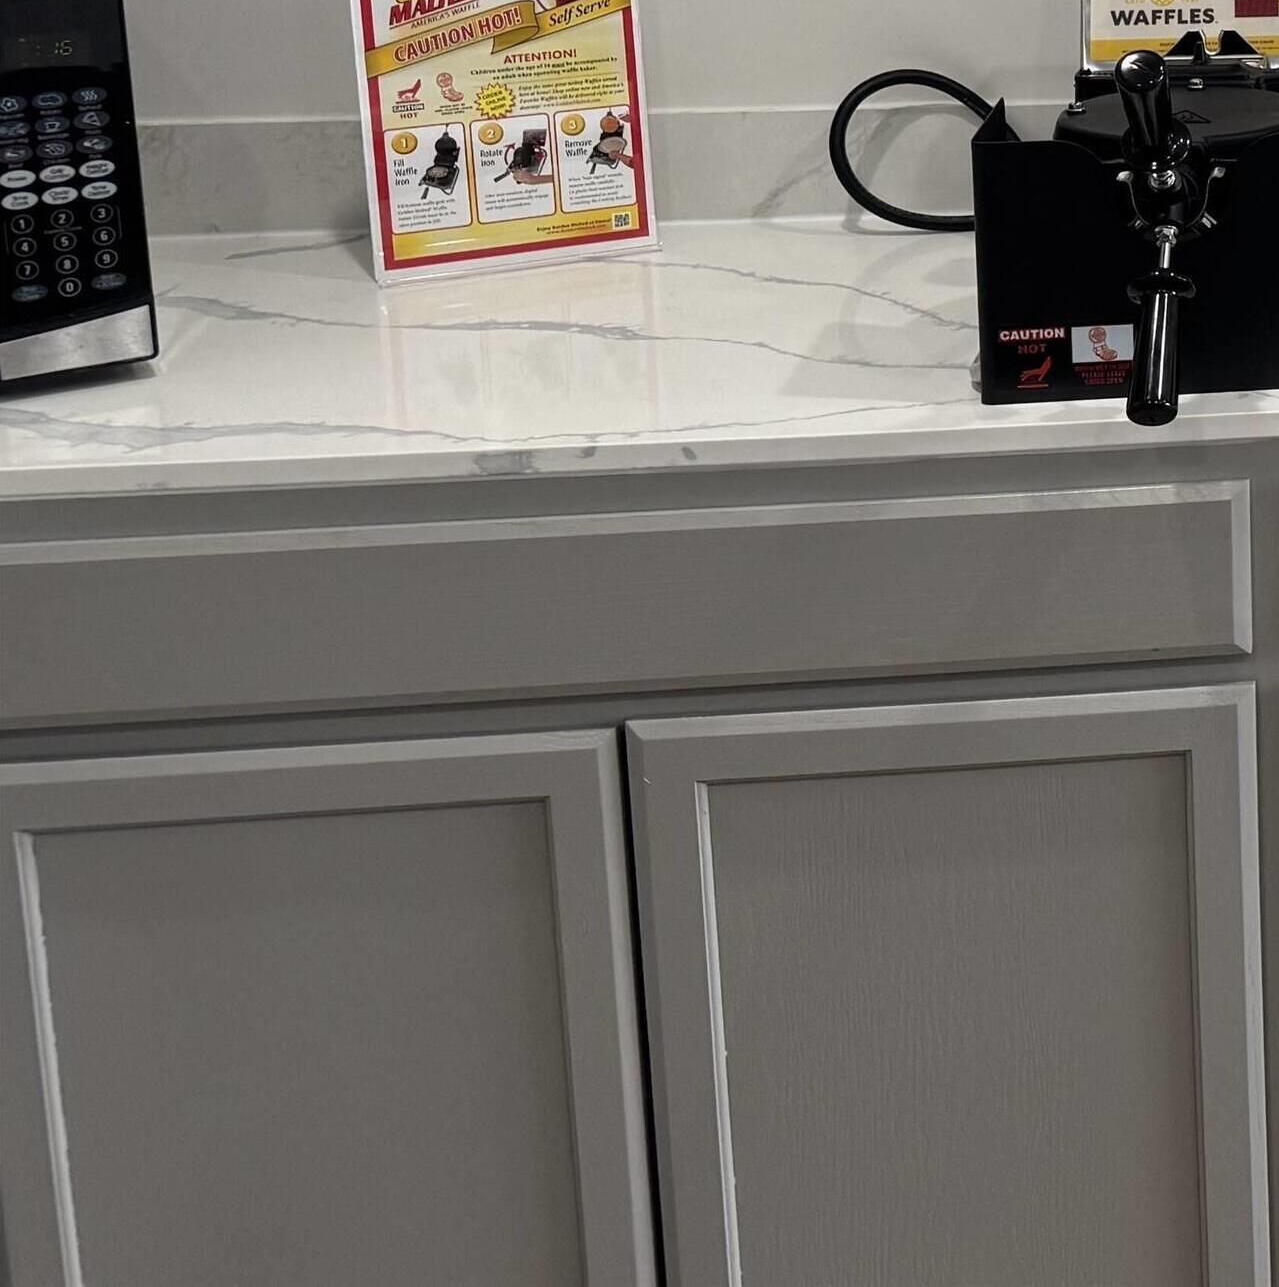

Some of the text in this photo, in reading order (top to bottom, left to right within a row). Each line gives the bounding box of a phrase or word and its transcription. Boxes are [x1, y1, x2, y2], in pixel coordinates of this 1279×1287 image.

[411, 1, 480, 29] AMERICA'S WAFFLE
[549, 5, 575, 26] Self
[1110, 8, 1215, 26] WAFFLES
[394, 6, 521, 62] CAUTION HOT!
[504, 49, 577, 65] ATTENTION!
[568, 120, 577, 130] 3
[487, 129, 495, 139] 2
[401, 137, 408, 149] 1
[565, 139, 593, 148] Remove
[480, 149, 503, 158] Rotate
[565, 147, 588, 157] Waffle
[394, 159, 405, 167] Fill
[394, 167, 418, 177] Waffle
[97, 208, 106, 218] 3
[58, 213, 66, 224] 2
[19, 219, 25, 229] 1
[100, 231, 108, 241] 6
[21, 241, 29, 252] 4
[61, 236, 69, 247] 5
[102, 254, 110, 264] 9
[63, 259, 71, 270] 8
[24, 265, 31, 275] 7
[66, 282, 74, 292] 0
[1000, 327, 1066, 341] CAUTION
[1017, 344, 1047, 355] HOT
